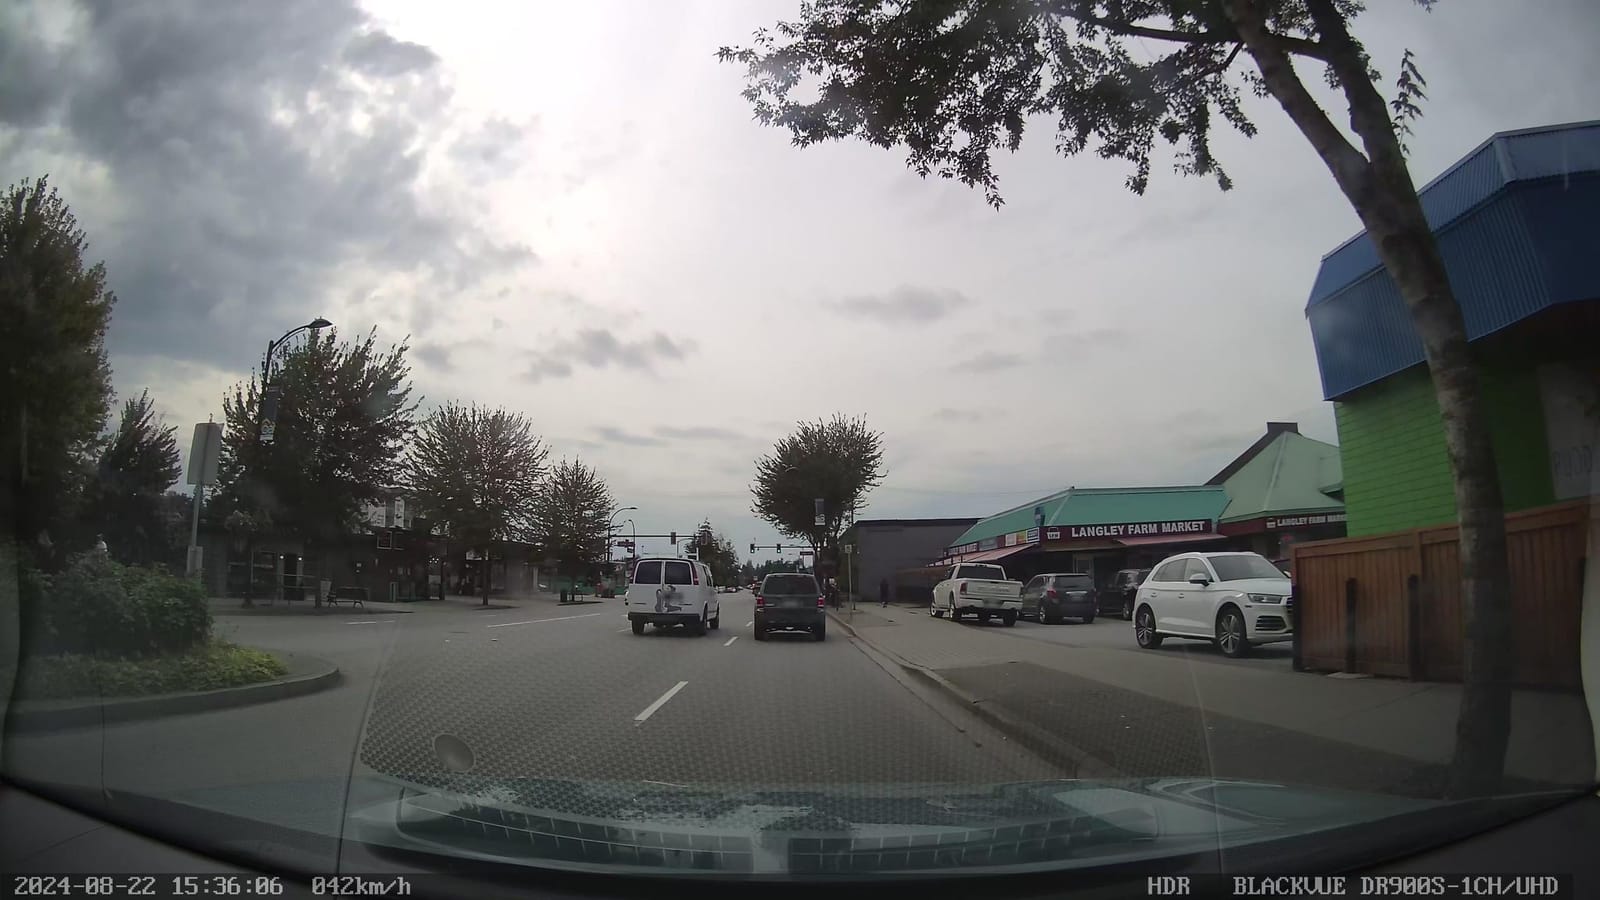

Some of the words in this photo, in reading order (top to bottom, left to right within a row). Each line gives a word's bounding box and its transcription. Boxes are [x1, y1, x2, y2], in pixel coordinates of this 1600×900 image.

[1071, 525, 1125, 538] LANGLEY
[1128, 523, 1158, 535] FARM
[1161, 521, 1205, 533] MARKET
